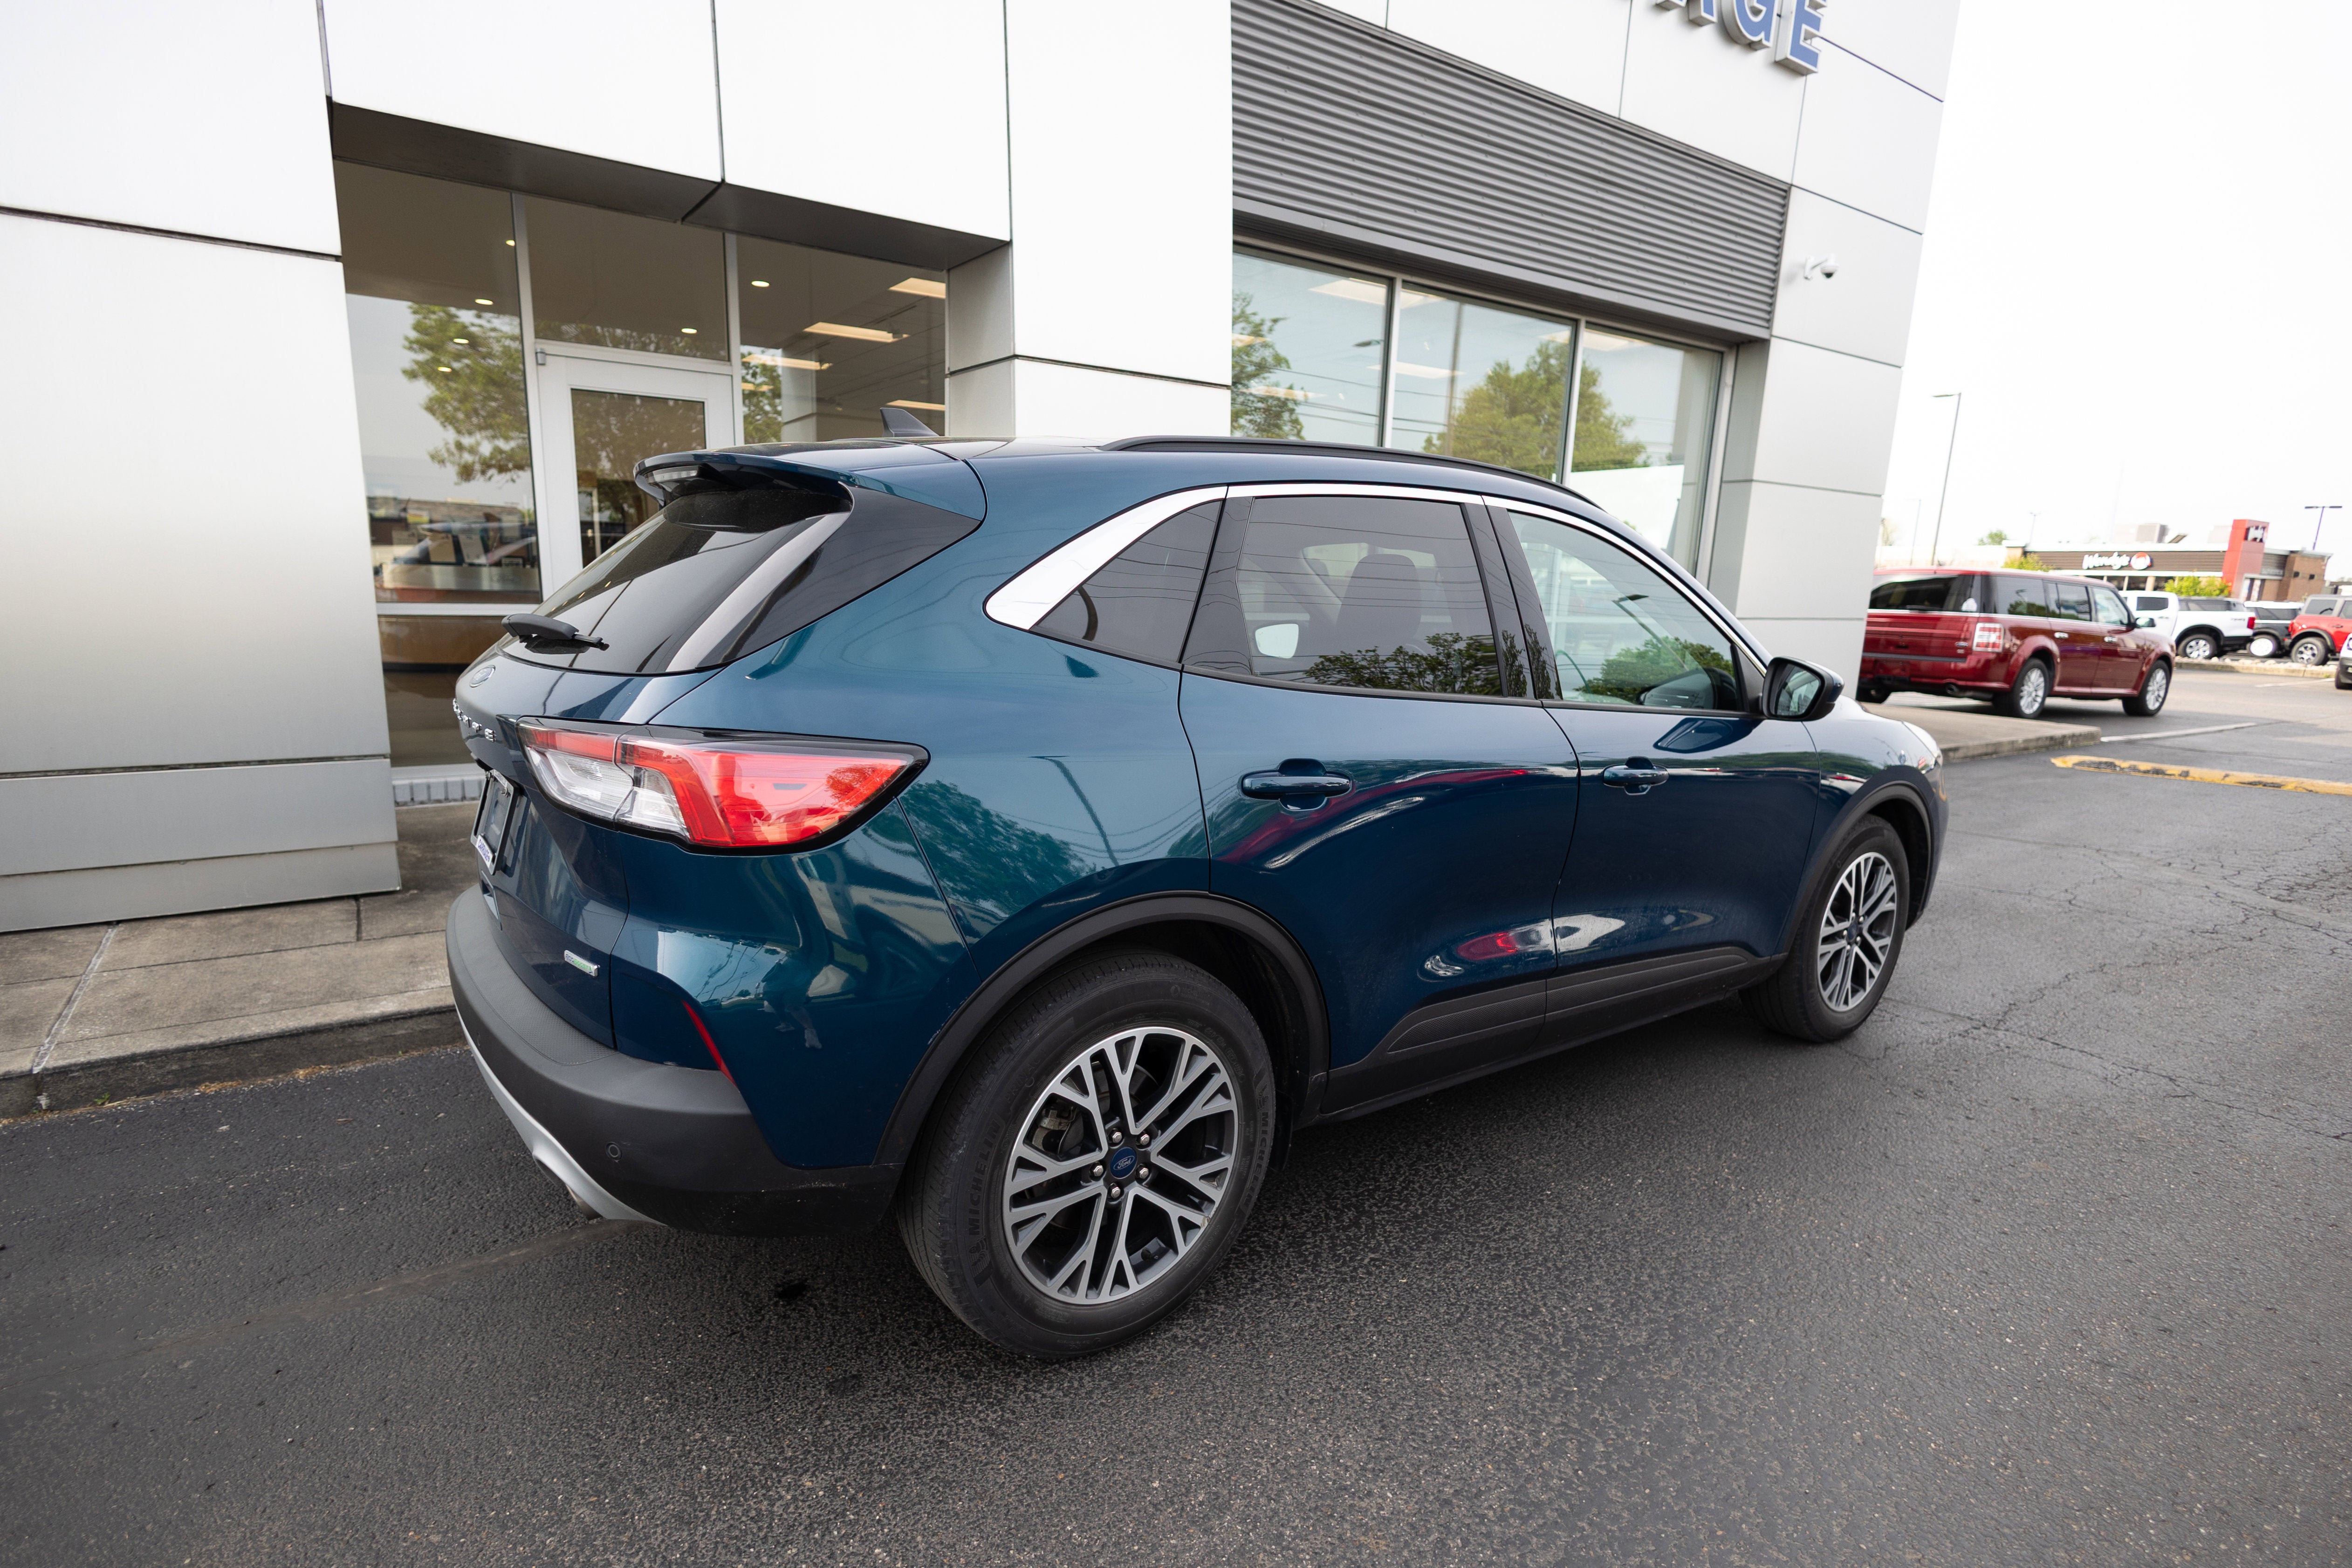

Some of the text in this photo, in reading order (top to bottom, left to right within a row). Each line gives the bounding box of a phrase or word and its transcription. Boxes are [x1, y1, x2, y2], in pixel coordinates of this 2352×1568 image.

[968, 1119, 1001, 1235] MICHELIN
[1118, 1157, 1131, 1169] Ford
[1242, 1111, 1269, 1208] MICHELIN
